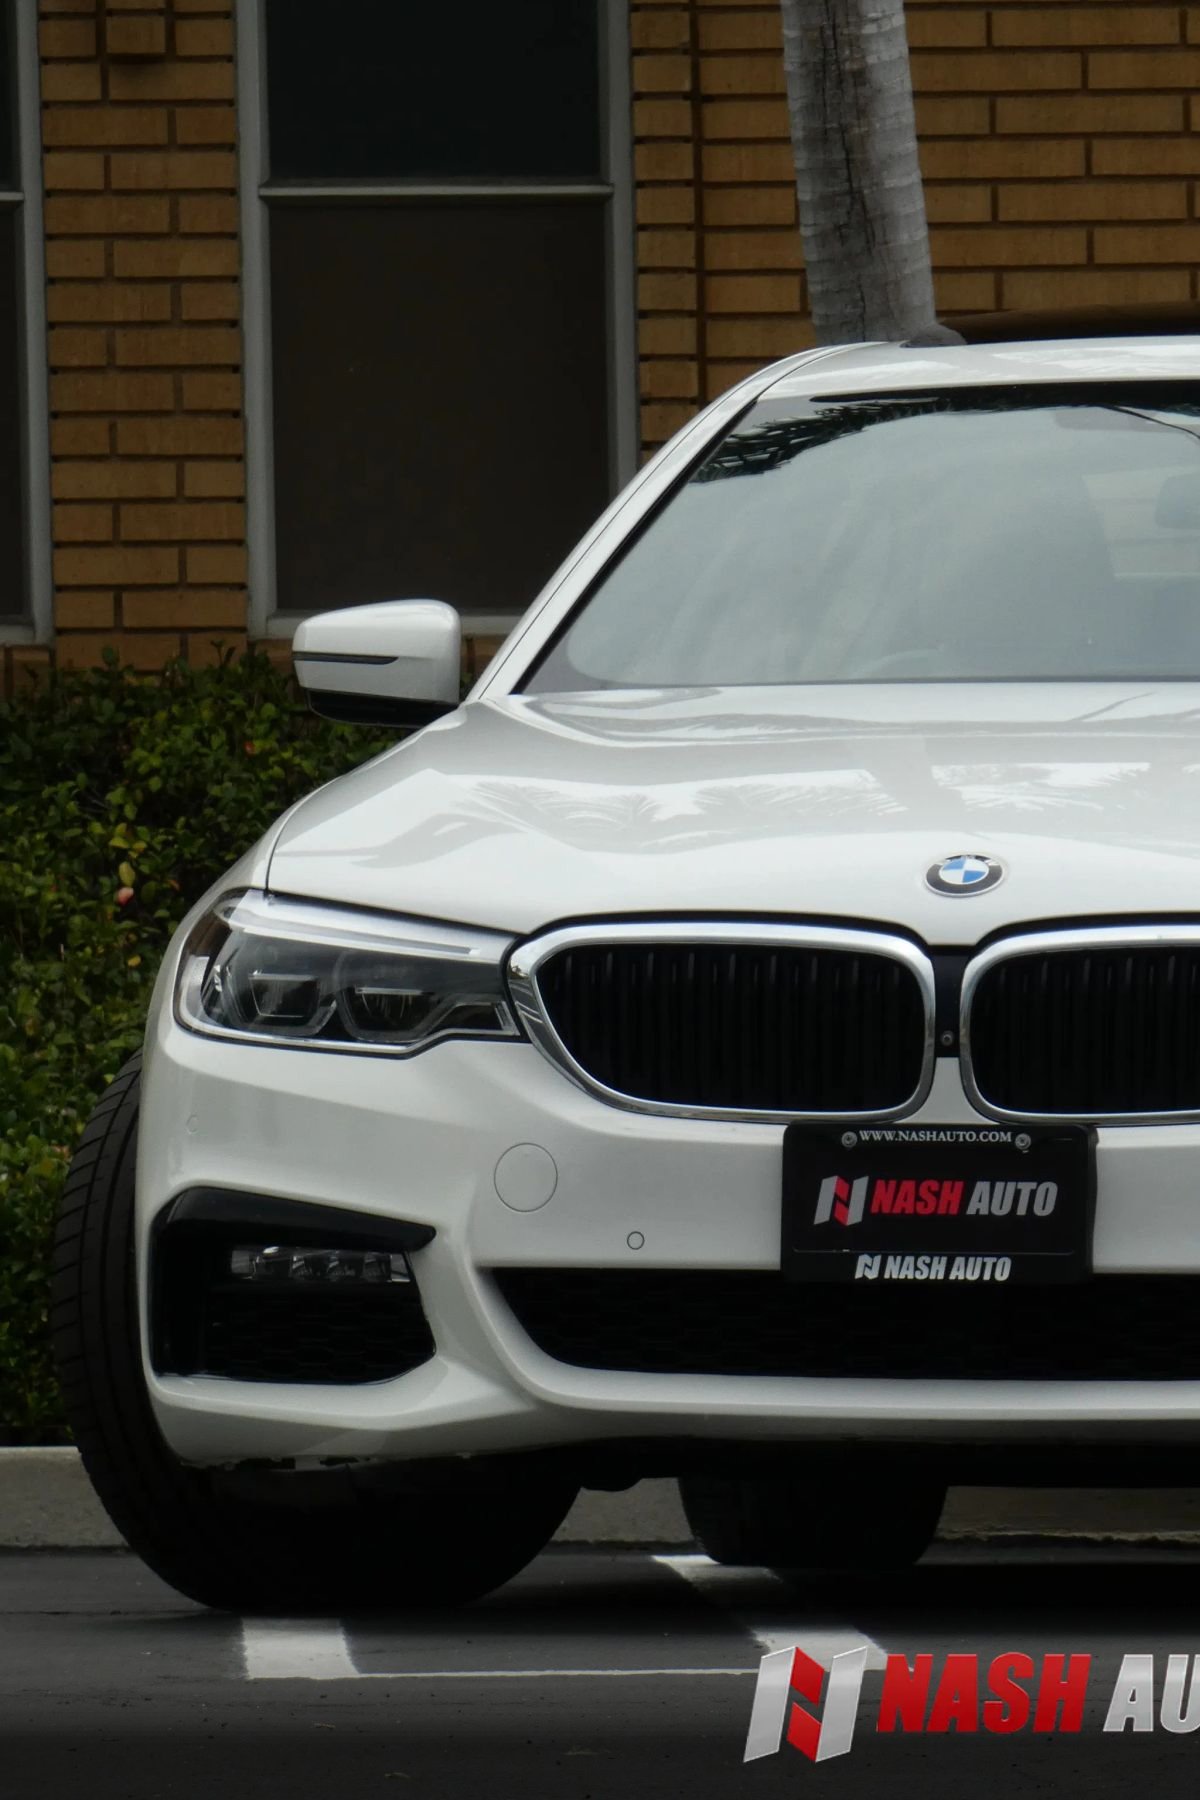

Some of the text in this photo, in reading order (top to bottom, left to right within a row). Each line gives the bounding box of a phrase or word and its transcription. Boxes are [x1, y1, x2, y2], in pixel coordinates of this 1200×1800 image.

[859, 1130, 1012, 1143] WWW.NASHAUTO.COM
[870, 1179, 965, 1215] NASH
[966, 1181, 1058, 1216] AUTO
[884, 1255, 949, 1280] NASH
[949, 1256, 1011, 1281] AUTO
